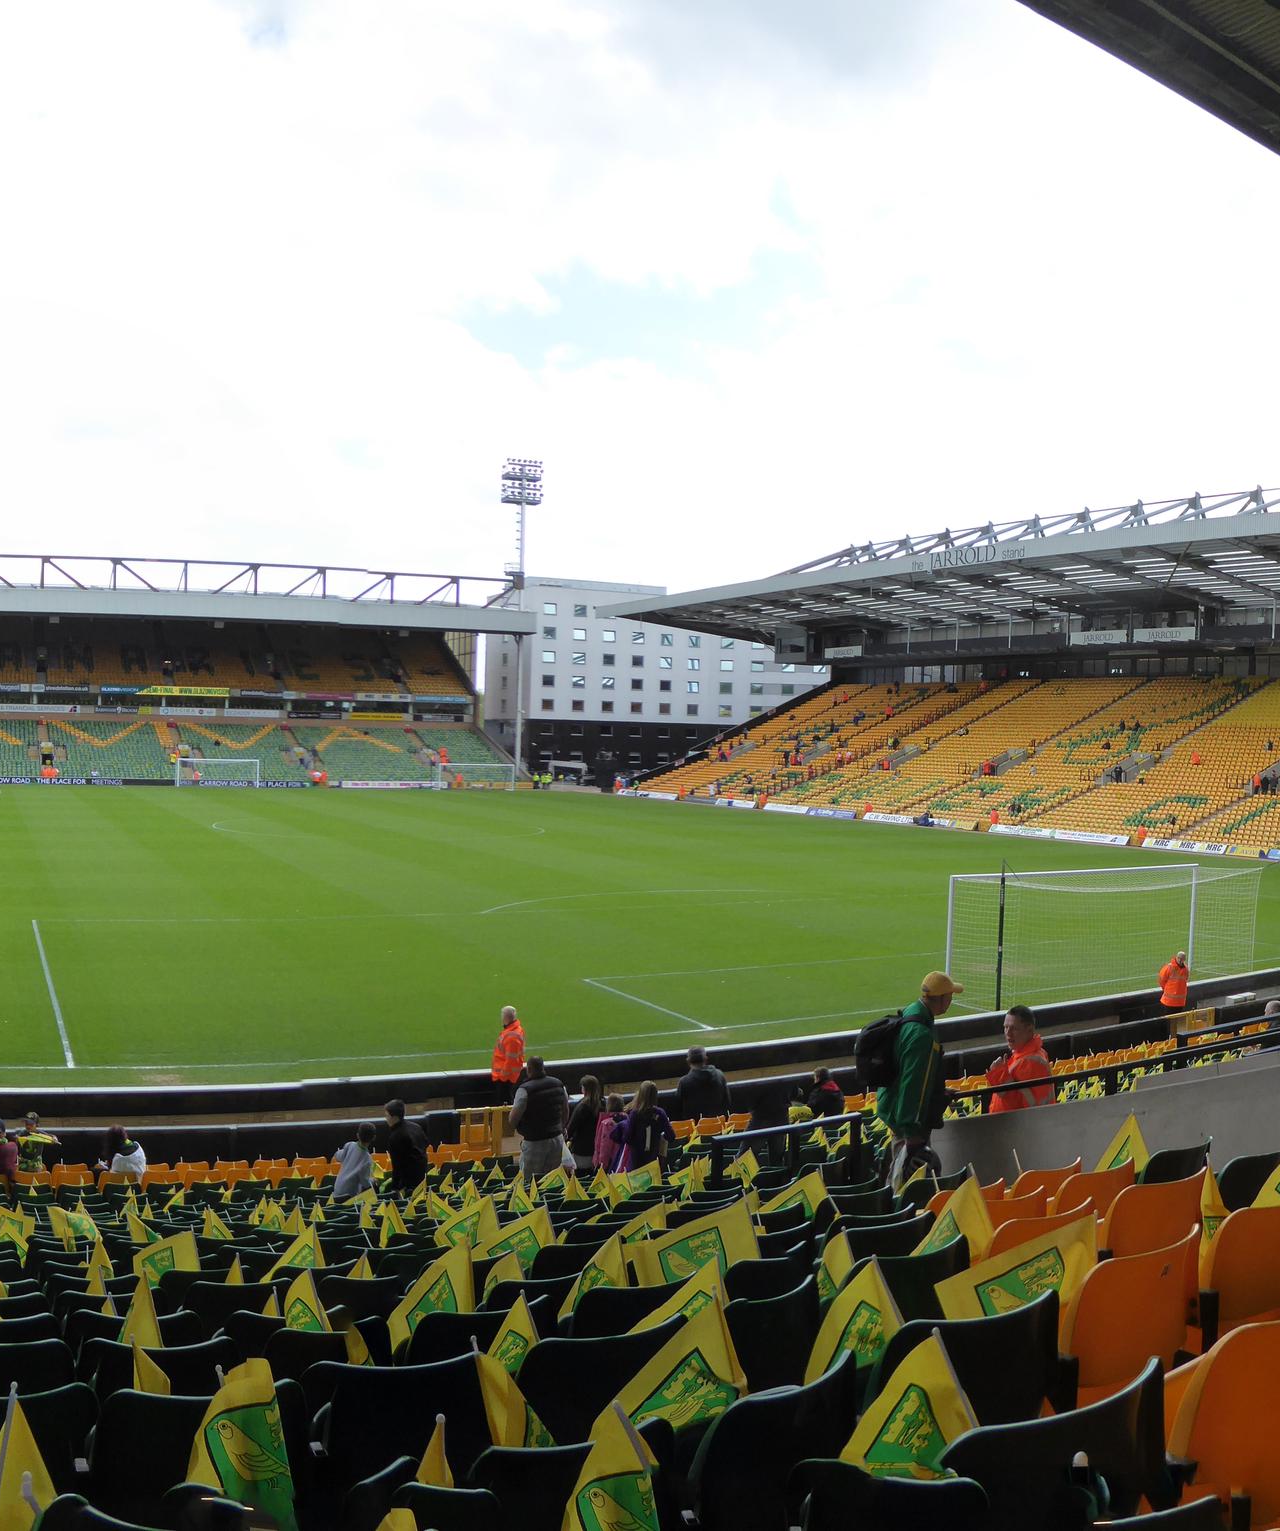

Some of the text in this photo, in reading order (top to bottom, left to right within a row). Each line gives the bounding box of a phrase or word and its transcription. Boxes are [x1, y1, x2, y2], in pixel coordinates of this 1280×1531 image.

[912, 545, 1025, 574] the JARROLD stand
[1083, 633, 1114, 643] JARROLD
[1147, 630, 1181, 641] JARROLD
[268, 780, 287, 788] PLACE
[1206, 844, 1223, 852] MRC
